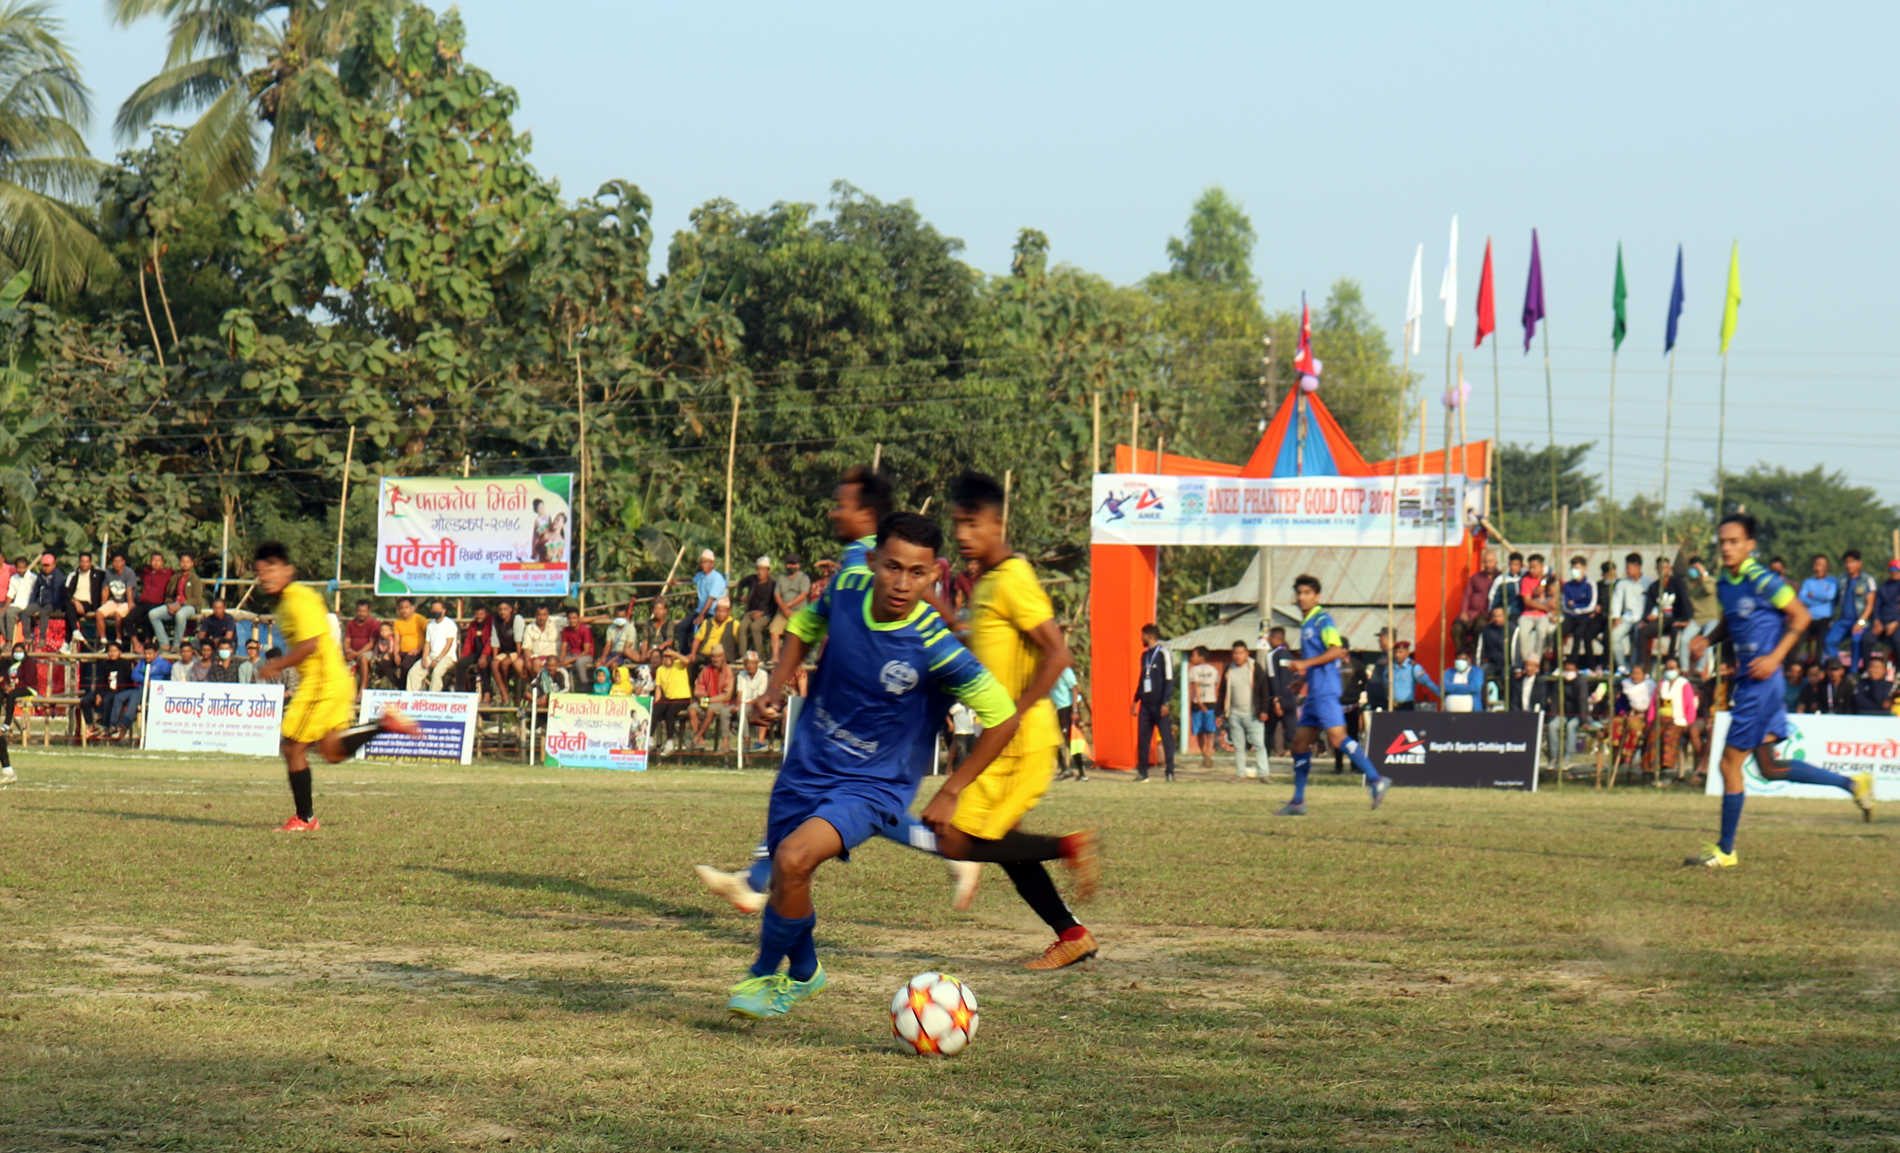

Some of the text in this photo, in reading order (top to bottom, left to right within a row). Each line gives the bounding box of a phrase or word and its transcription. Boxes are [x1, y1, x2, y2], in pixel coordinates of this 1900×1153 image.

[415, 483, 528, 511] फाक्तेप मिनी
[1207, 488, 1240, 515] ANEE
[1243, 487, 1301, 515] PHAKTEP
[1304, 488, 1338, 515] GOLD
[1341, 488, 1366, 515] CUP
[385, 537, 458, 574] पुर्वेली
[164, 692, 277, 718] कन्काई गार्मेन्ट उद्योग
[410, 699, 448, 713] मेडिकल
[604, 699, 628, 716] मिनी
[1384, 754, 1426, 765] ANEE
[1826, 737, 1900, 760] फाक्ते
